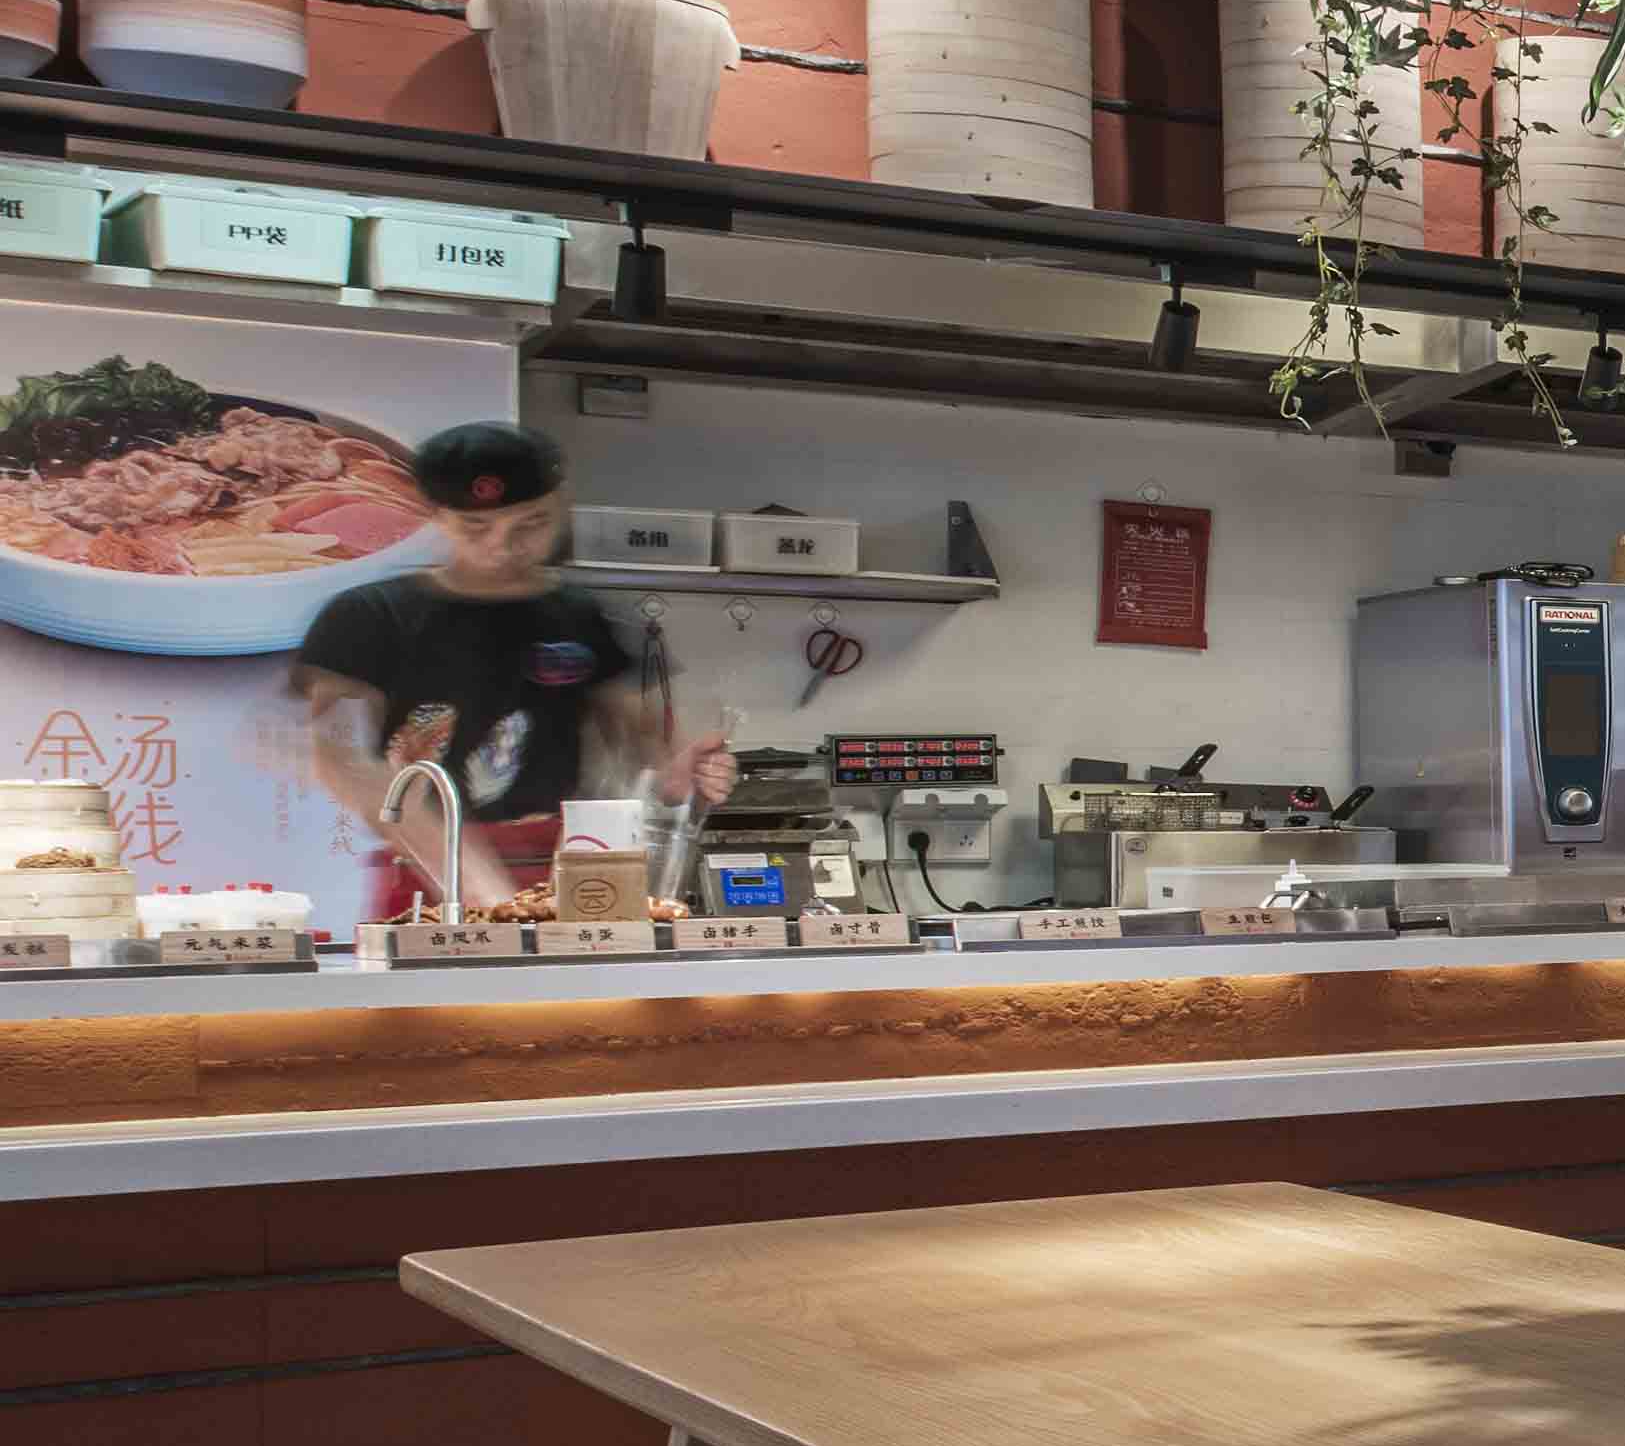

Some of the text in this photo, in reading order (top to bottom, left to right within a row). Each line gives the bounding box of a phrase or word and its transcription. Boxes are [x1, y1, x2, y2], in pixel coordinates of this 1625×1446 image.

[436, 243, 505, 267] 打包袋
[1544, 610, 1596, 619] RATIONAL
